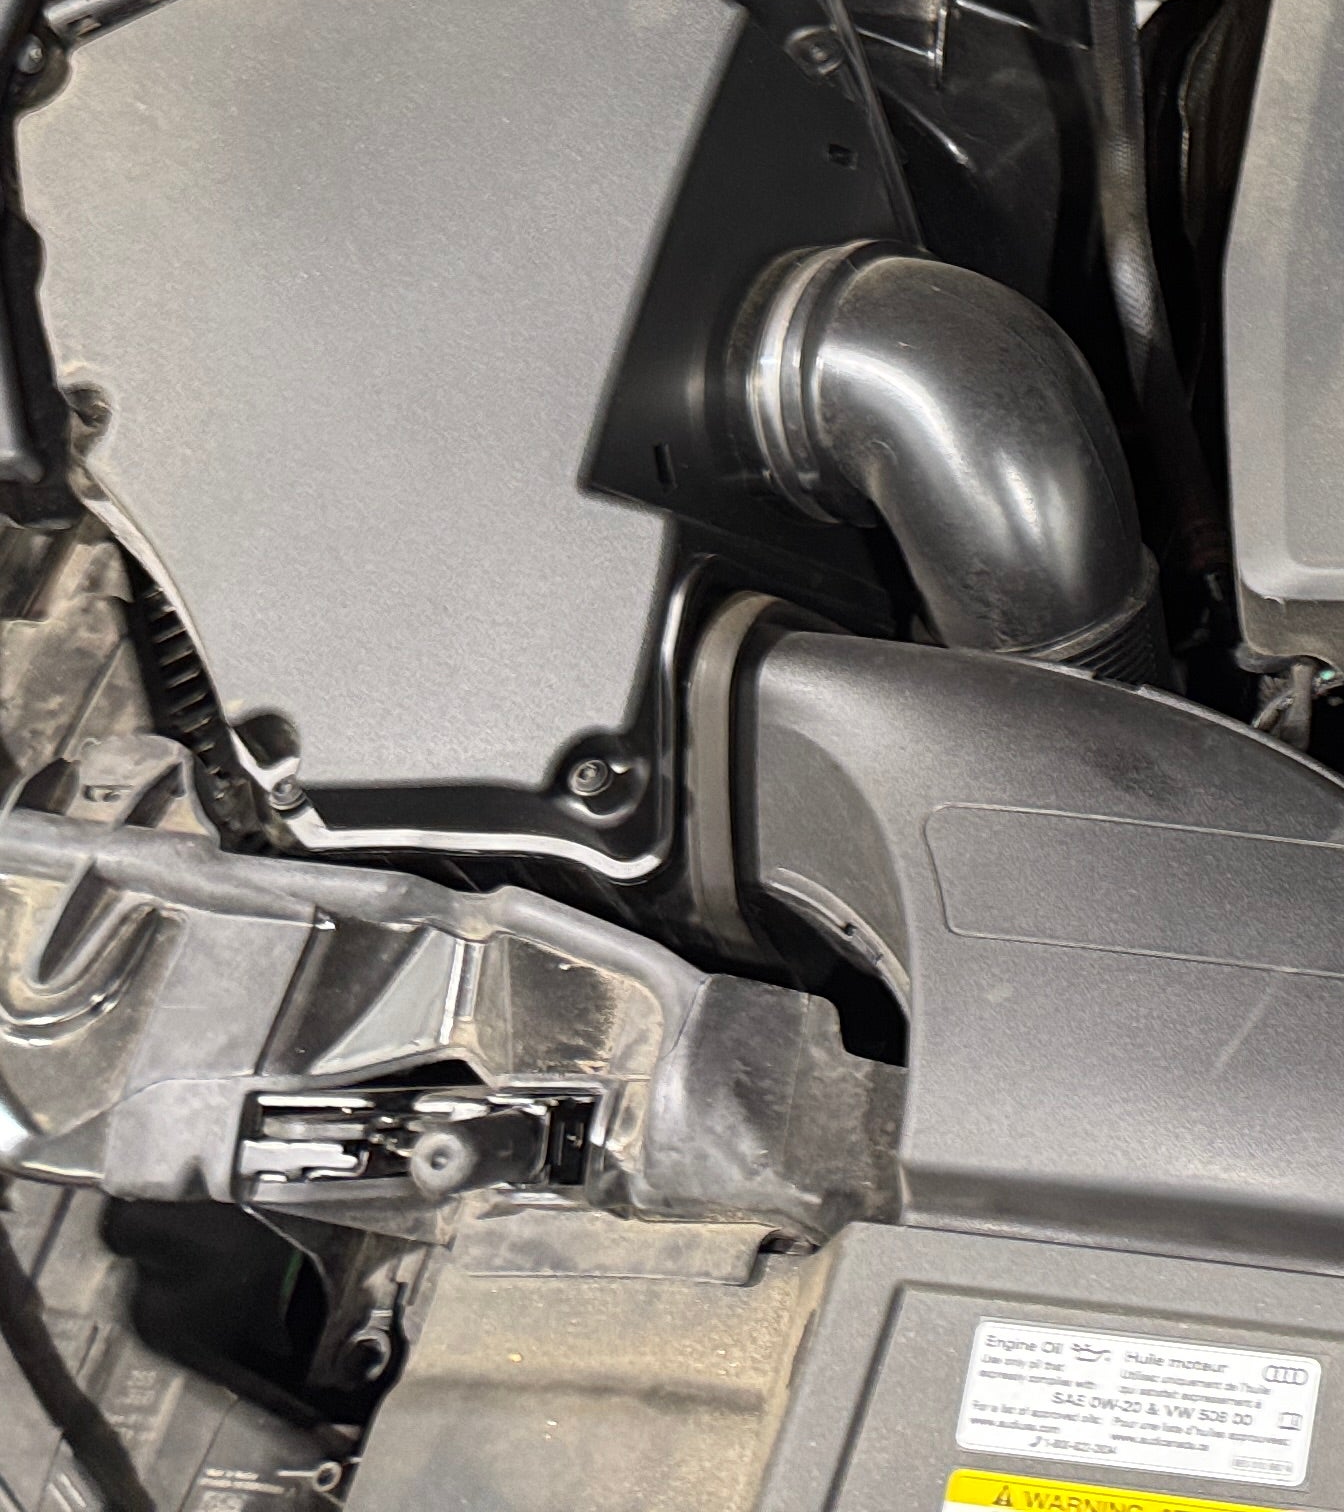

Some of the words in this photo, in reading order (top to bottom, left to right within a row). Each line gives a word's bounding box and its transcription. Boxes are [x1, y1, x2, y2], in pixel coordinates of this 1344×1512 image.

[985, 1334, 1038, 1352] Engine
[1041, 1341, 1064, 1354] Oil
[1124, 1350, 1165, 1367] Huile
[1168, 1357, 1229, 1373] moteur
[1051, 1391, 1087, 1408] SAE
[1088, 1396, 1143, 1413] 0W-20
[1145, 1401, 1160, 1416] &
[1164, 1404, 1195, 1419] VW
[1231, 1412, 1253, 1426] 00
